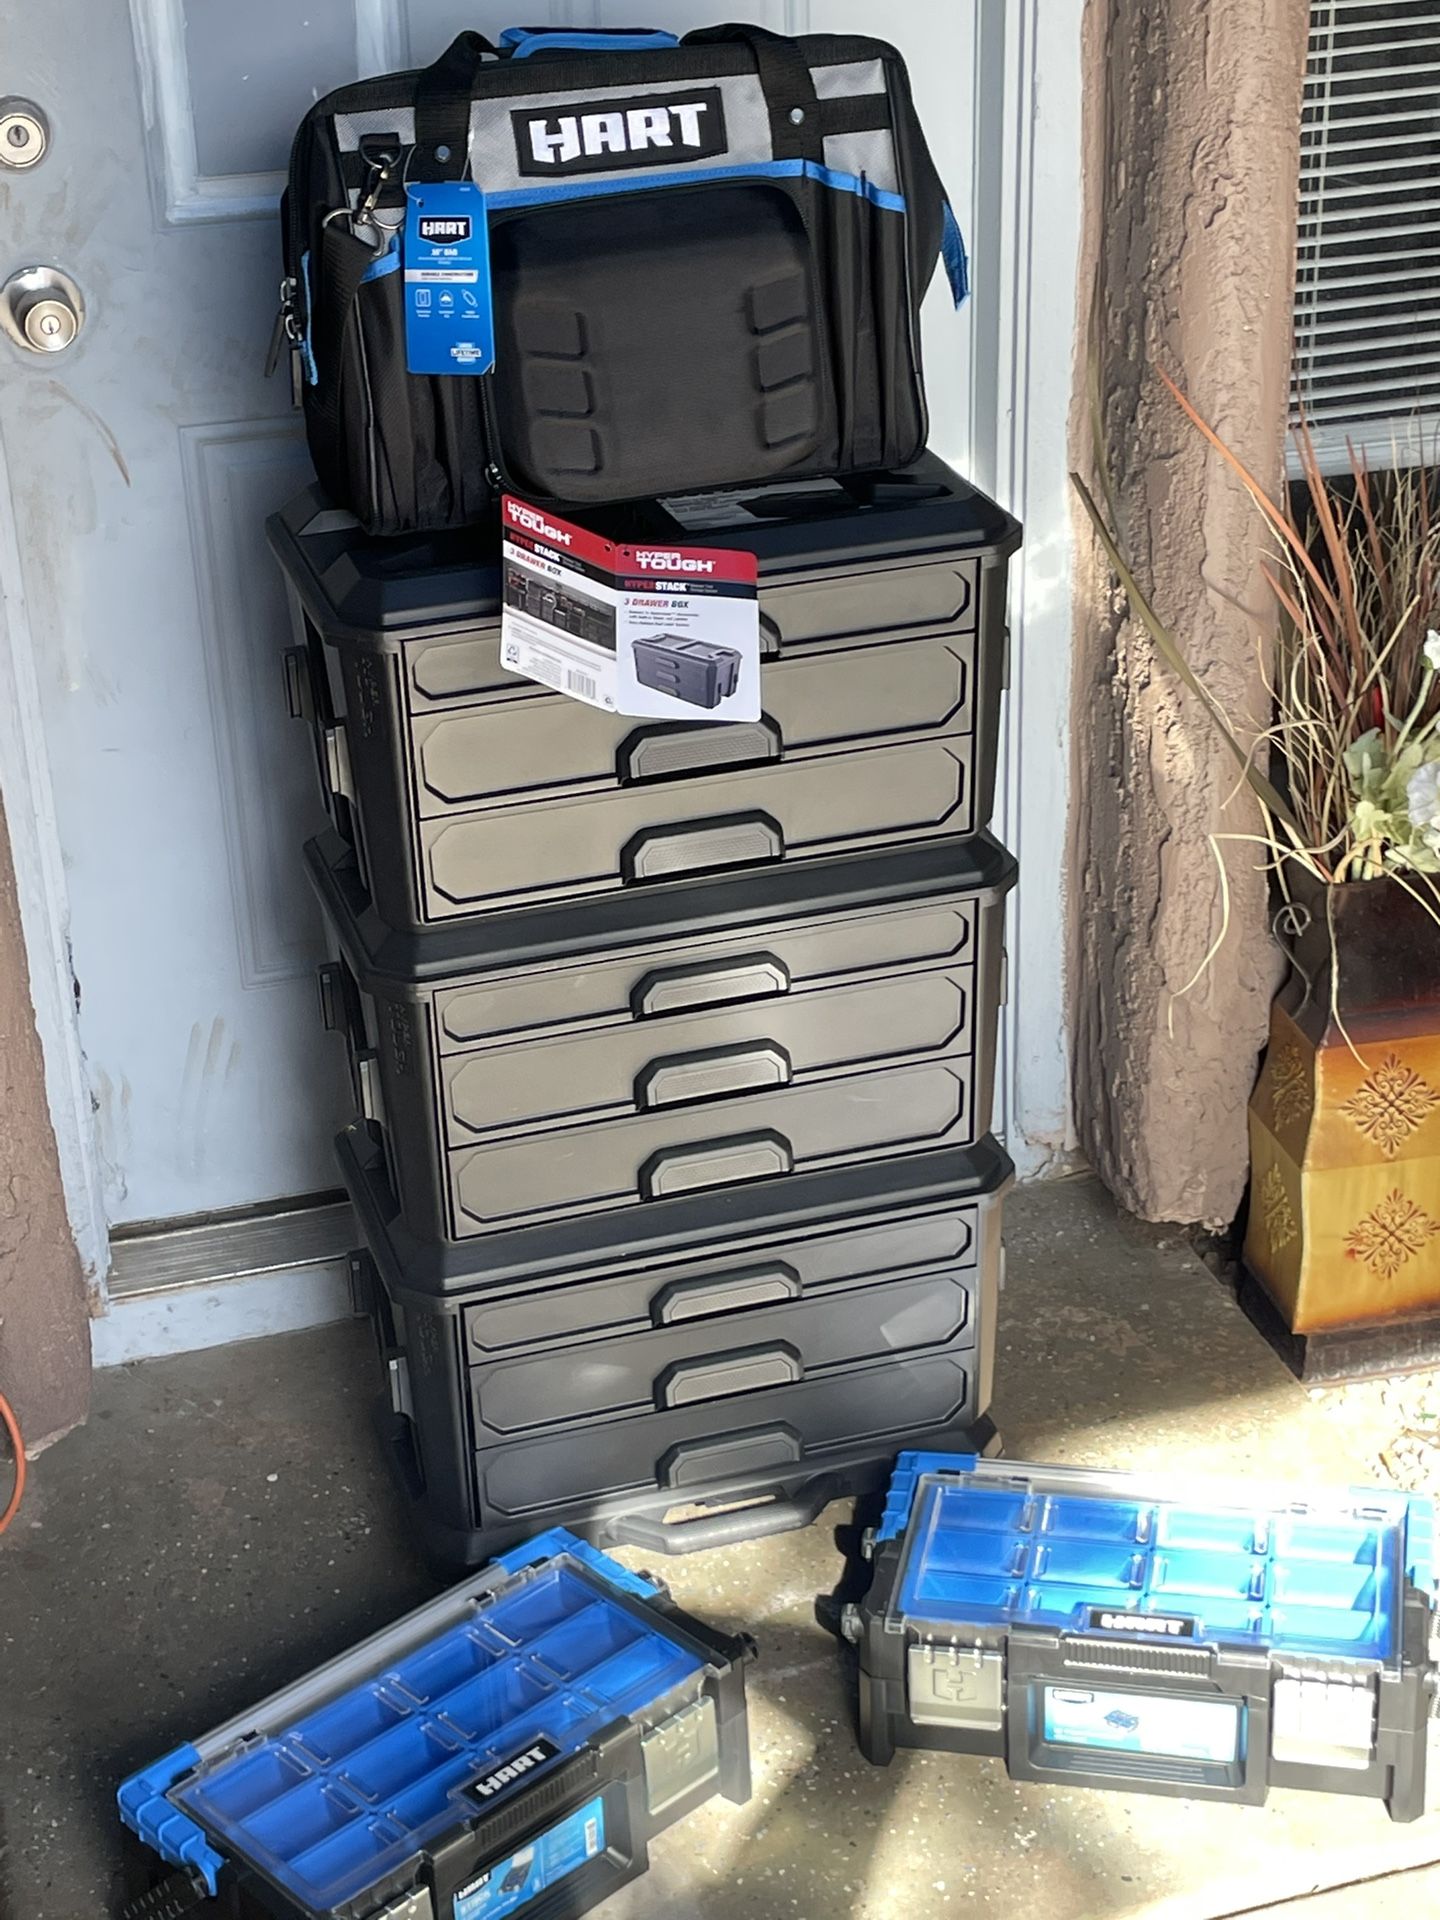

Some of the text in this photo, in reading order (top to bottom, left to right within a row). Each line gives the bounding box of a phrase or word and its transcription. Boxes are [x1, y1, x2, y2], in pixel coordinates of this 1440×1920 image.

[528, 102, 708, 164] HART
[421, 221, 467, 236] HART
[511, 511, 570, 546] TOUGH
[635, 550, 681, 562] HYPER
[640, 559, 713, 573] TOUGH
[631, 598, 669, 608] DRAWER
[670, 600, 689, 609] BOX
[475, 1746, 547, 1796] HART
